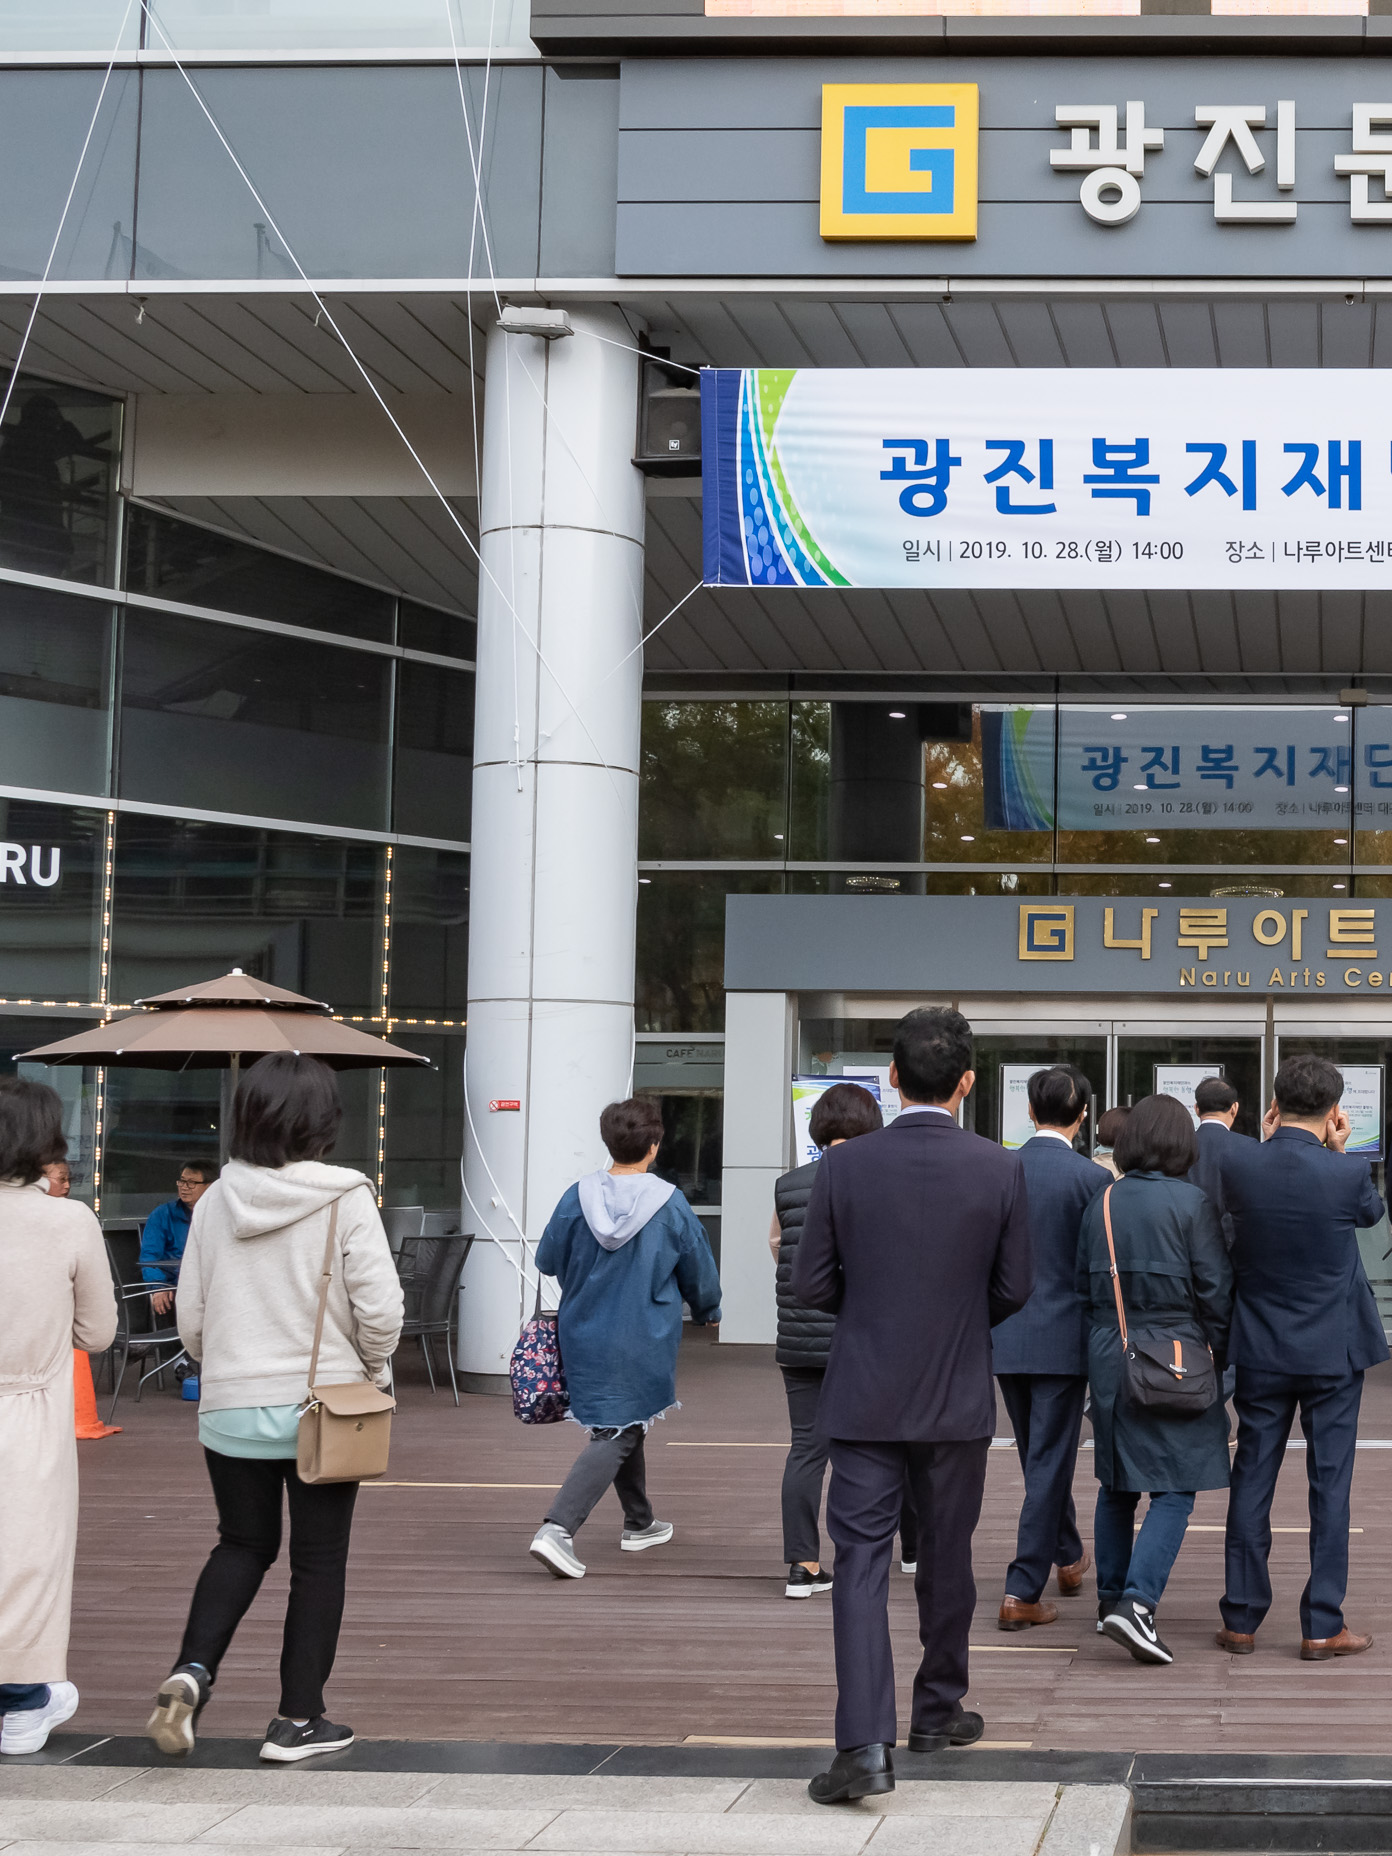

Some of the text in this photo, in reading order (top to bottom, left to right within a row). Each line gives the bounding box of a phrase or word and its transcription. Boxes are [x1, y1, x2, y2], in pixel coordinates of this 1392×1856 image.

[902, 540, 941, 562] 일시
[959, 541, 1011, 559] 2019.
[1022, 541, 1047, 559] 10.
[1055, 540, 1122, 563] 28.(월)
[1132, 541, 1184, 559] 14:00
[1225, 541, 1265, 564] 장소
[1179, 967, 1250, 987] Naru
[1269, 967, 1326, 987] Arts
